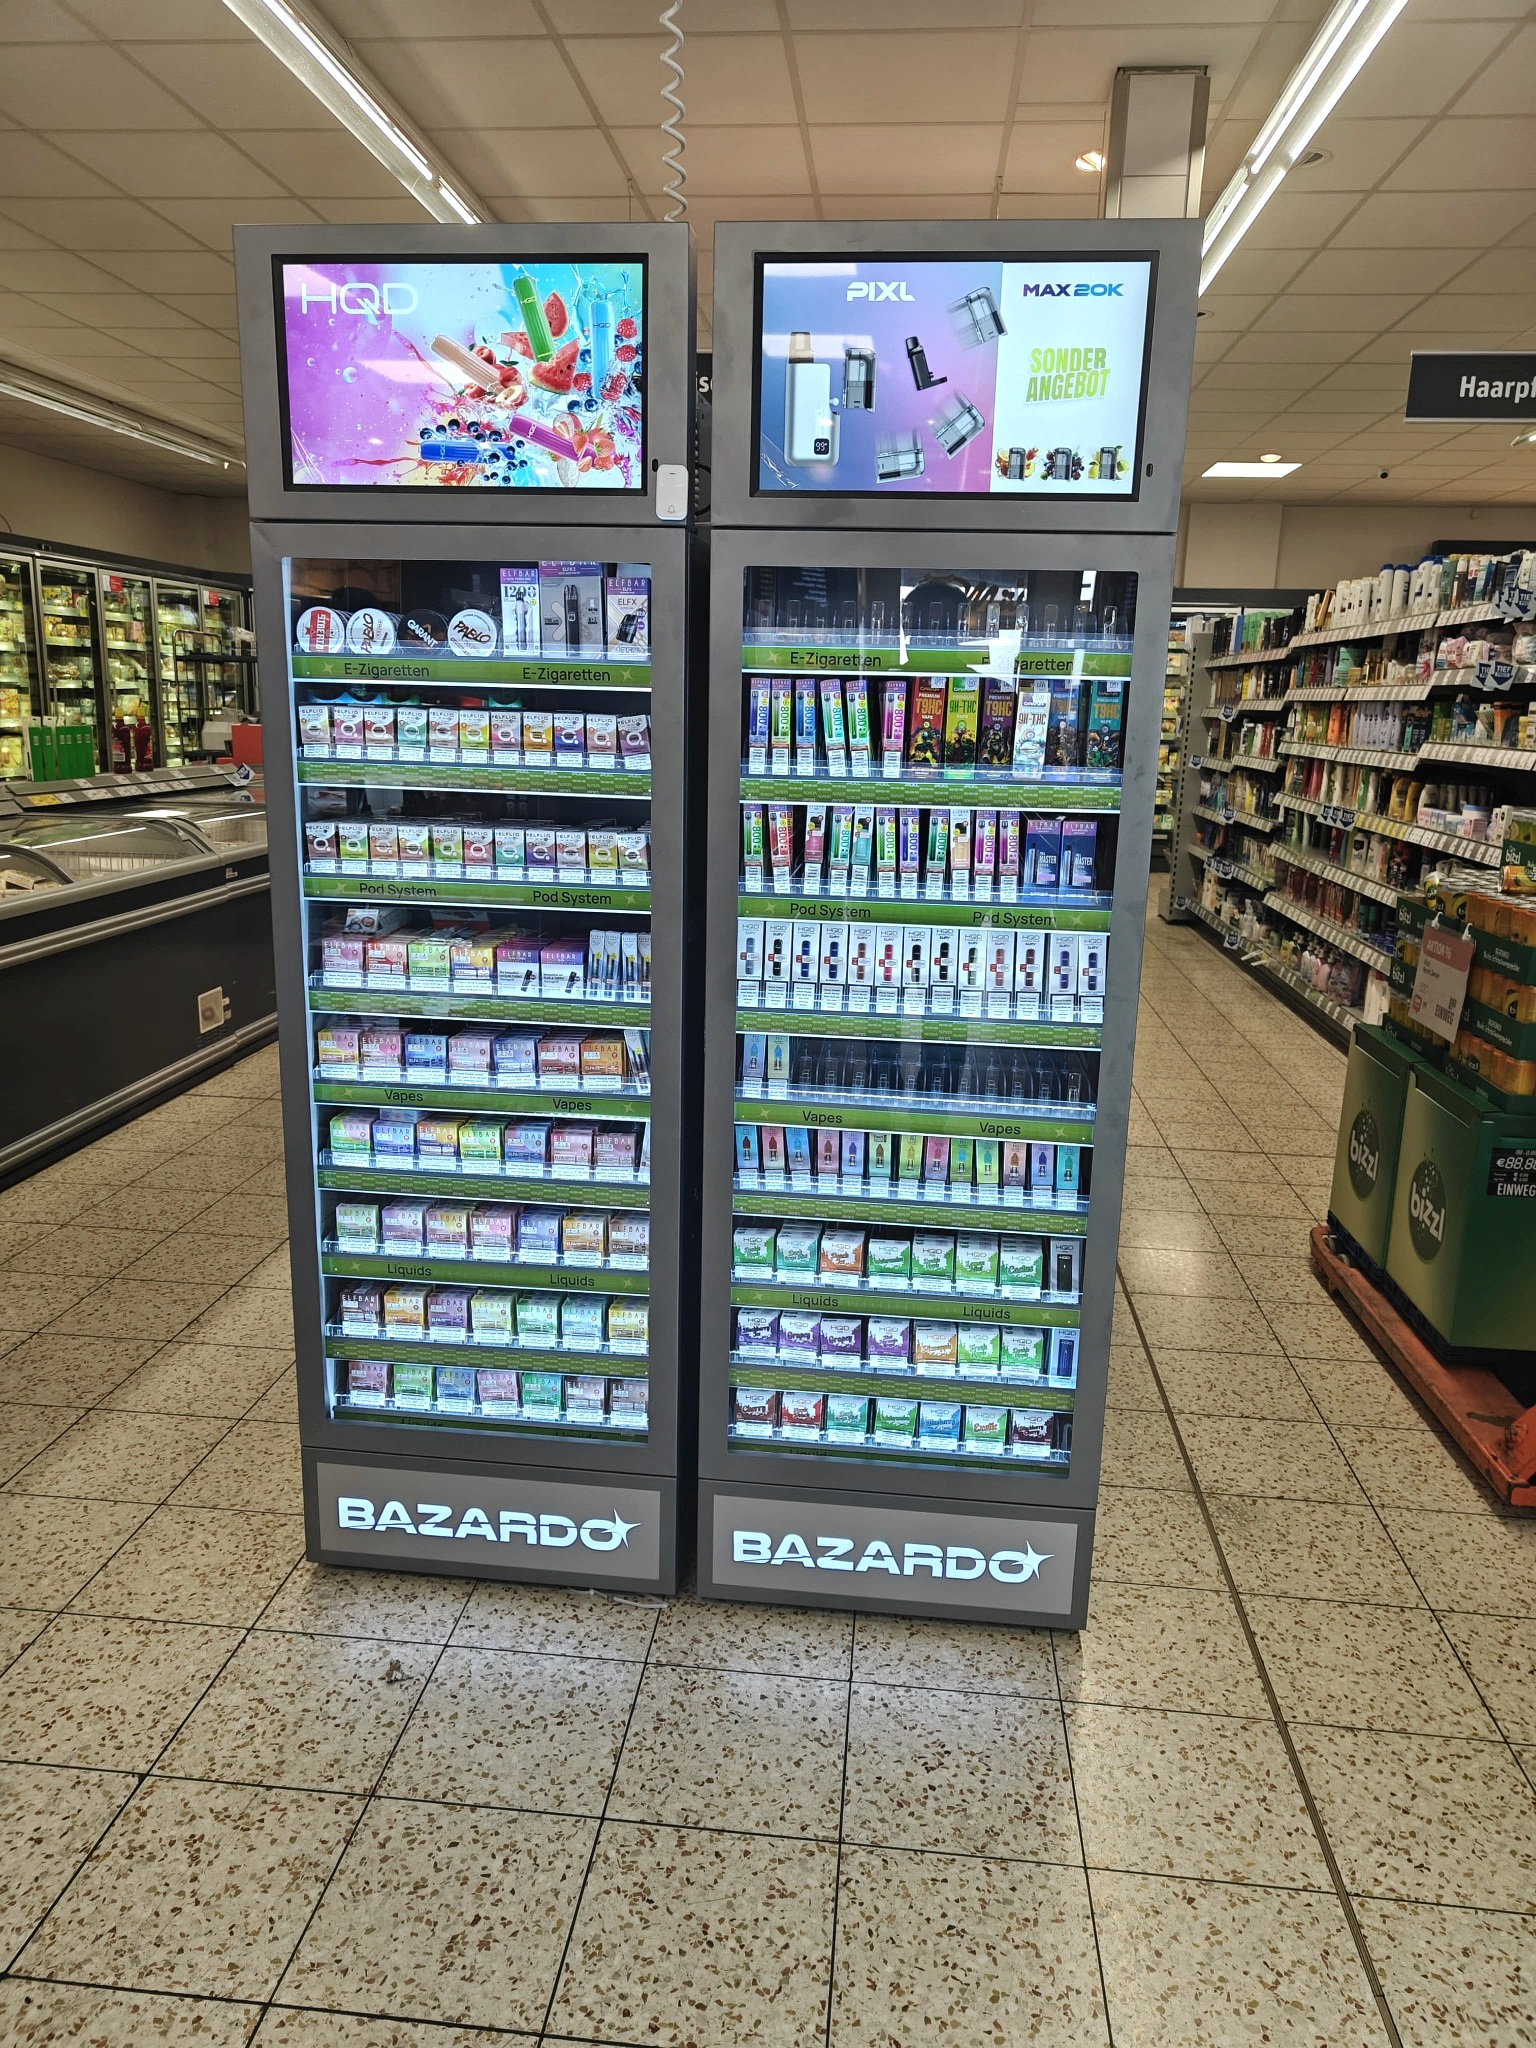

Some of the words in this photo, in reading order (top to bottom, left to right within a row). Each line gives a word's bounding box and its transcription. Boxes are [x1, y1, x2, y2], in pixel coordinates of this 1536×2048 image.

[846, 281, 916, 302] PIXL
[1023, 283, 1071, 297] MAX
[1073, 283, 1124, 297] 20K
[301, 282, 418, 315] HQD
[1030, 347, 1107, 374] SONDER
[1025, 368, 1111, 402] ANGEBOT
[502, 569, 535, 577] ELFBAR
[608, 579, 646, 587] ELFBAR
[617, 598, 637, 606] ELFX
[361, 612, 375, 654] PABLO
[407, 618, 439, 649] GARANT
[453, 620, 492, 644] PABLO
[790, 651, 882, 668] E-Zigaretten
[344, 662, 430, 679] E-Zigaretten
[522, 667, 611, 683] E-Zigaretten
[1497, 665, 1511, 673] TIEF
[915, 698, 942, 715] T9HC
[949, 700, 977, 713] 9H-THC
[985, 701, 1012, 717] T9HC
[1093, 703, 1120, 719] T9HC
[759, 706, 768, 726] 800
[781, 706, 789, 726] 800
[805, 706, 814, 726] 800
[832, 707, 843, 727] 800
[857, 707, 867, 728] 800
[894, 709, 904, 728] 800
[1018, 712, 1046, 726] 9H-THC
[752, 826, 761, 844] 800
[779, 827, 788, 845] 800
[841, 829, 850, 848] 800
[886, 831, 894, 849] 800
[909, 832, 918, 850] 800
[937, 832, 946, 851] 800
[985, 835, 993, 853] 800
[1009, 835, 1017, 853] 800
[1039, 855, 1057, 864] MASTER
[1075, 857, 1093, 866] MASTER
[359, 882, 384, 894] Pod
[387, 884, 437, 899] System
[533, 890, 558, 903] Pod
[561, 892, 612, 906] System
[790, 902, 816, 915] Pod
[819, 904, 871, 919] System
[972, 911, 1000, 924] Pod
[1003, 912, 1056, 928] System
[367, 943, 406, 951] ELFBAR
[502, 950, 532, 958] ELFBAR
[546, 952, 576, 960] ELFBAR
[362, 1037, 397, 1045] ELFBAR
[407, 1038, 443, 1046] ELFBAR
[384, 1089, 424, 1104] Vapes
[552, 1098, 592, 1113] Vapes
[802, 1110, 843, 1126] Vapes
[375, 1127, 410, 1135] ELFBAR
[979, 1121, 1021, 1137] Vapes
[1350, 1130, 1379, 1181] bizzl
[1497, 1182, 1536, 1197] EINWEG
[1410, 1182, 1445, 1242] bizzl
[472, 1218, 507, 1226] ELFBAR
[387, 1263, 432, 1277] Liquids
[1008, 1264, 1034, 1274] Cactus
[550, 1274, 595, 1287] Liquids
[341, 1294, 375, 1303] ELFBAR
[792, 1294, 839, 1308] Liquids
[963, 1306, 1011, 1320] Liquids
[338, 1497, 632, 1551] BAZARDO
[733, 1530, 1042, 1584] BAZARDO
